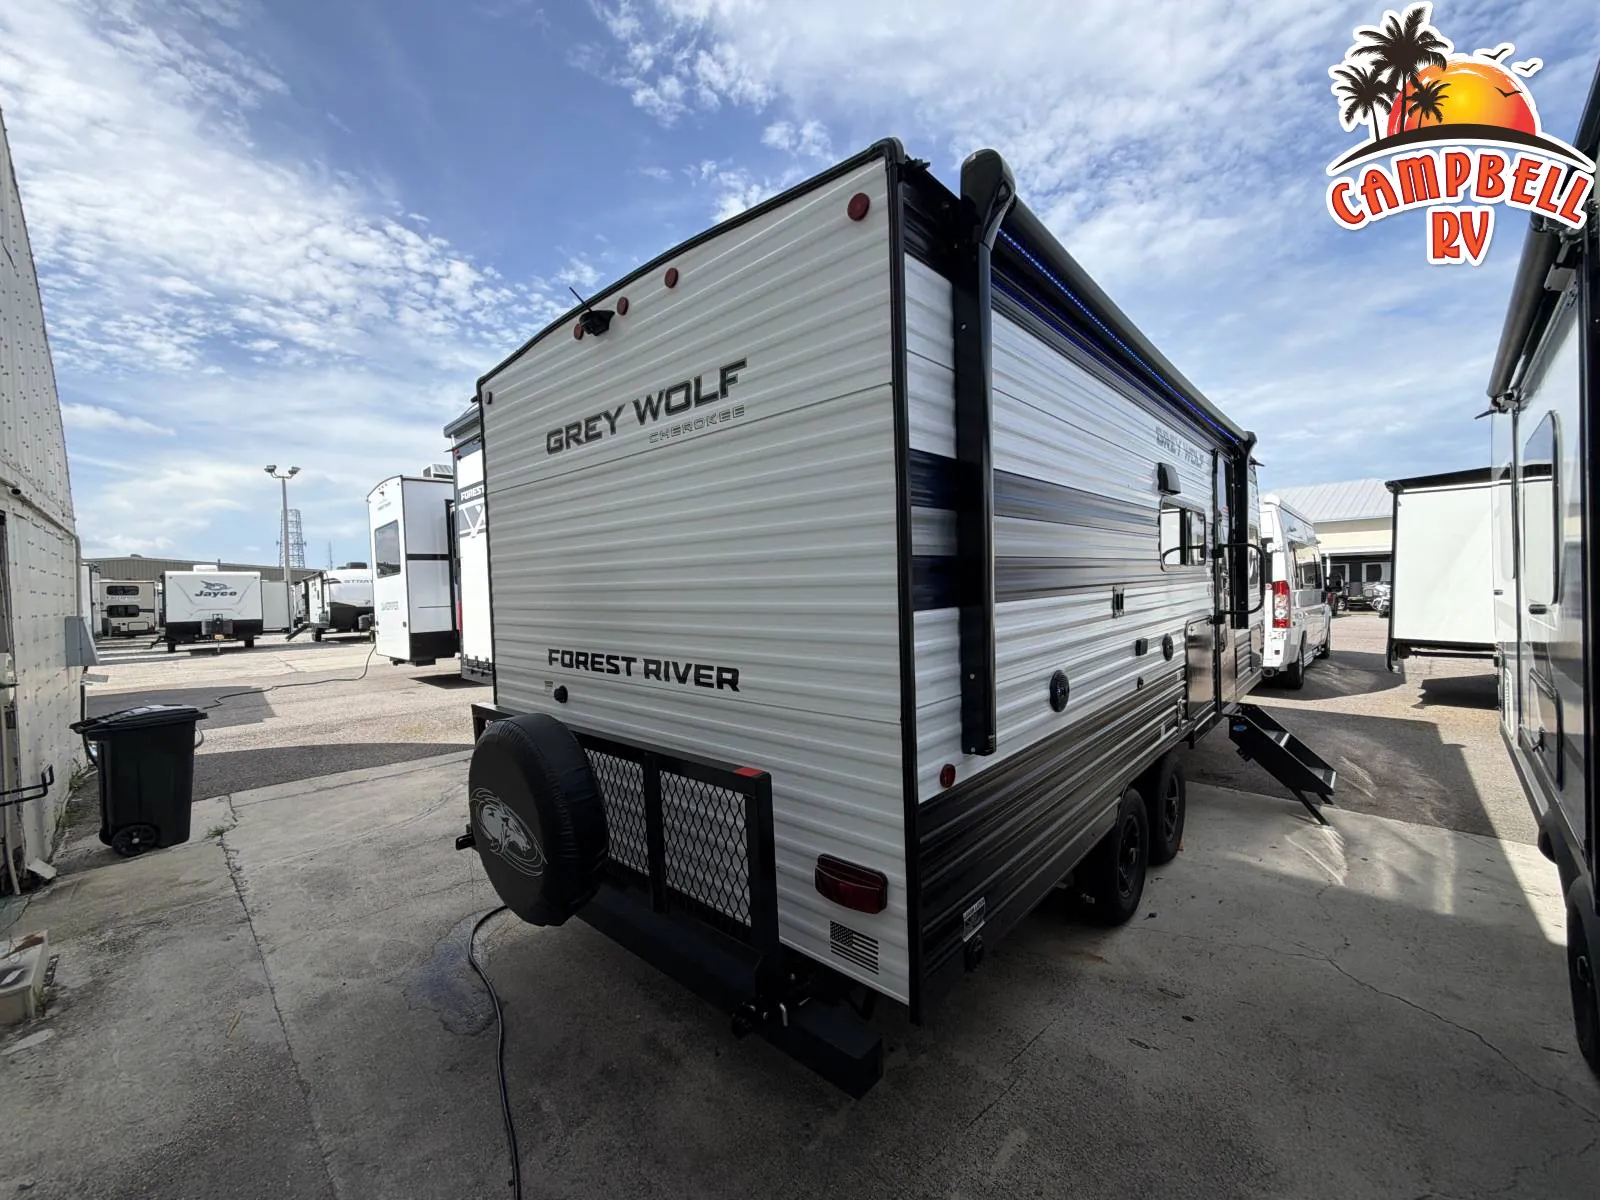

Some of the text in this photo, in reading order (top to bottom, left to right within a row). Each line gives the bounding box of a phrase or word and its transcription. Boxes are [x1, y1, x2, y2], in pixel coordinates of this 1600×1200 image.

[546, 357, 748, 455] GREY WOLF
[649, 404, 745, 444] CHEROKEE
[194, 590, 238, 598] Jayco
[548, 649, 741, 693] FOREST RIVER
